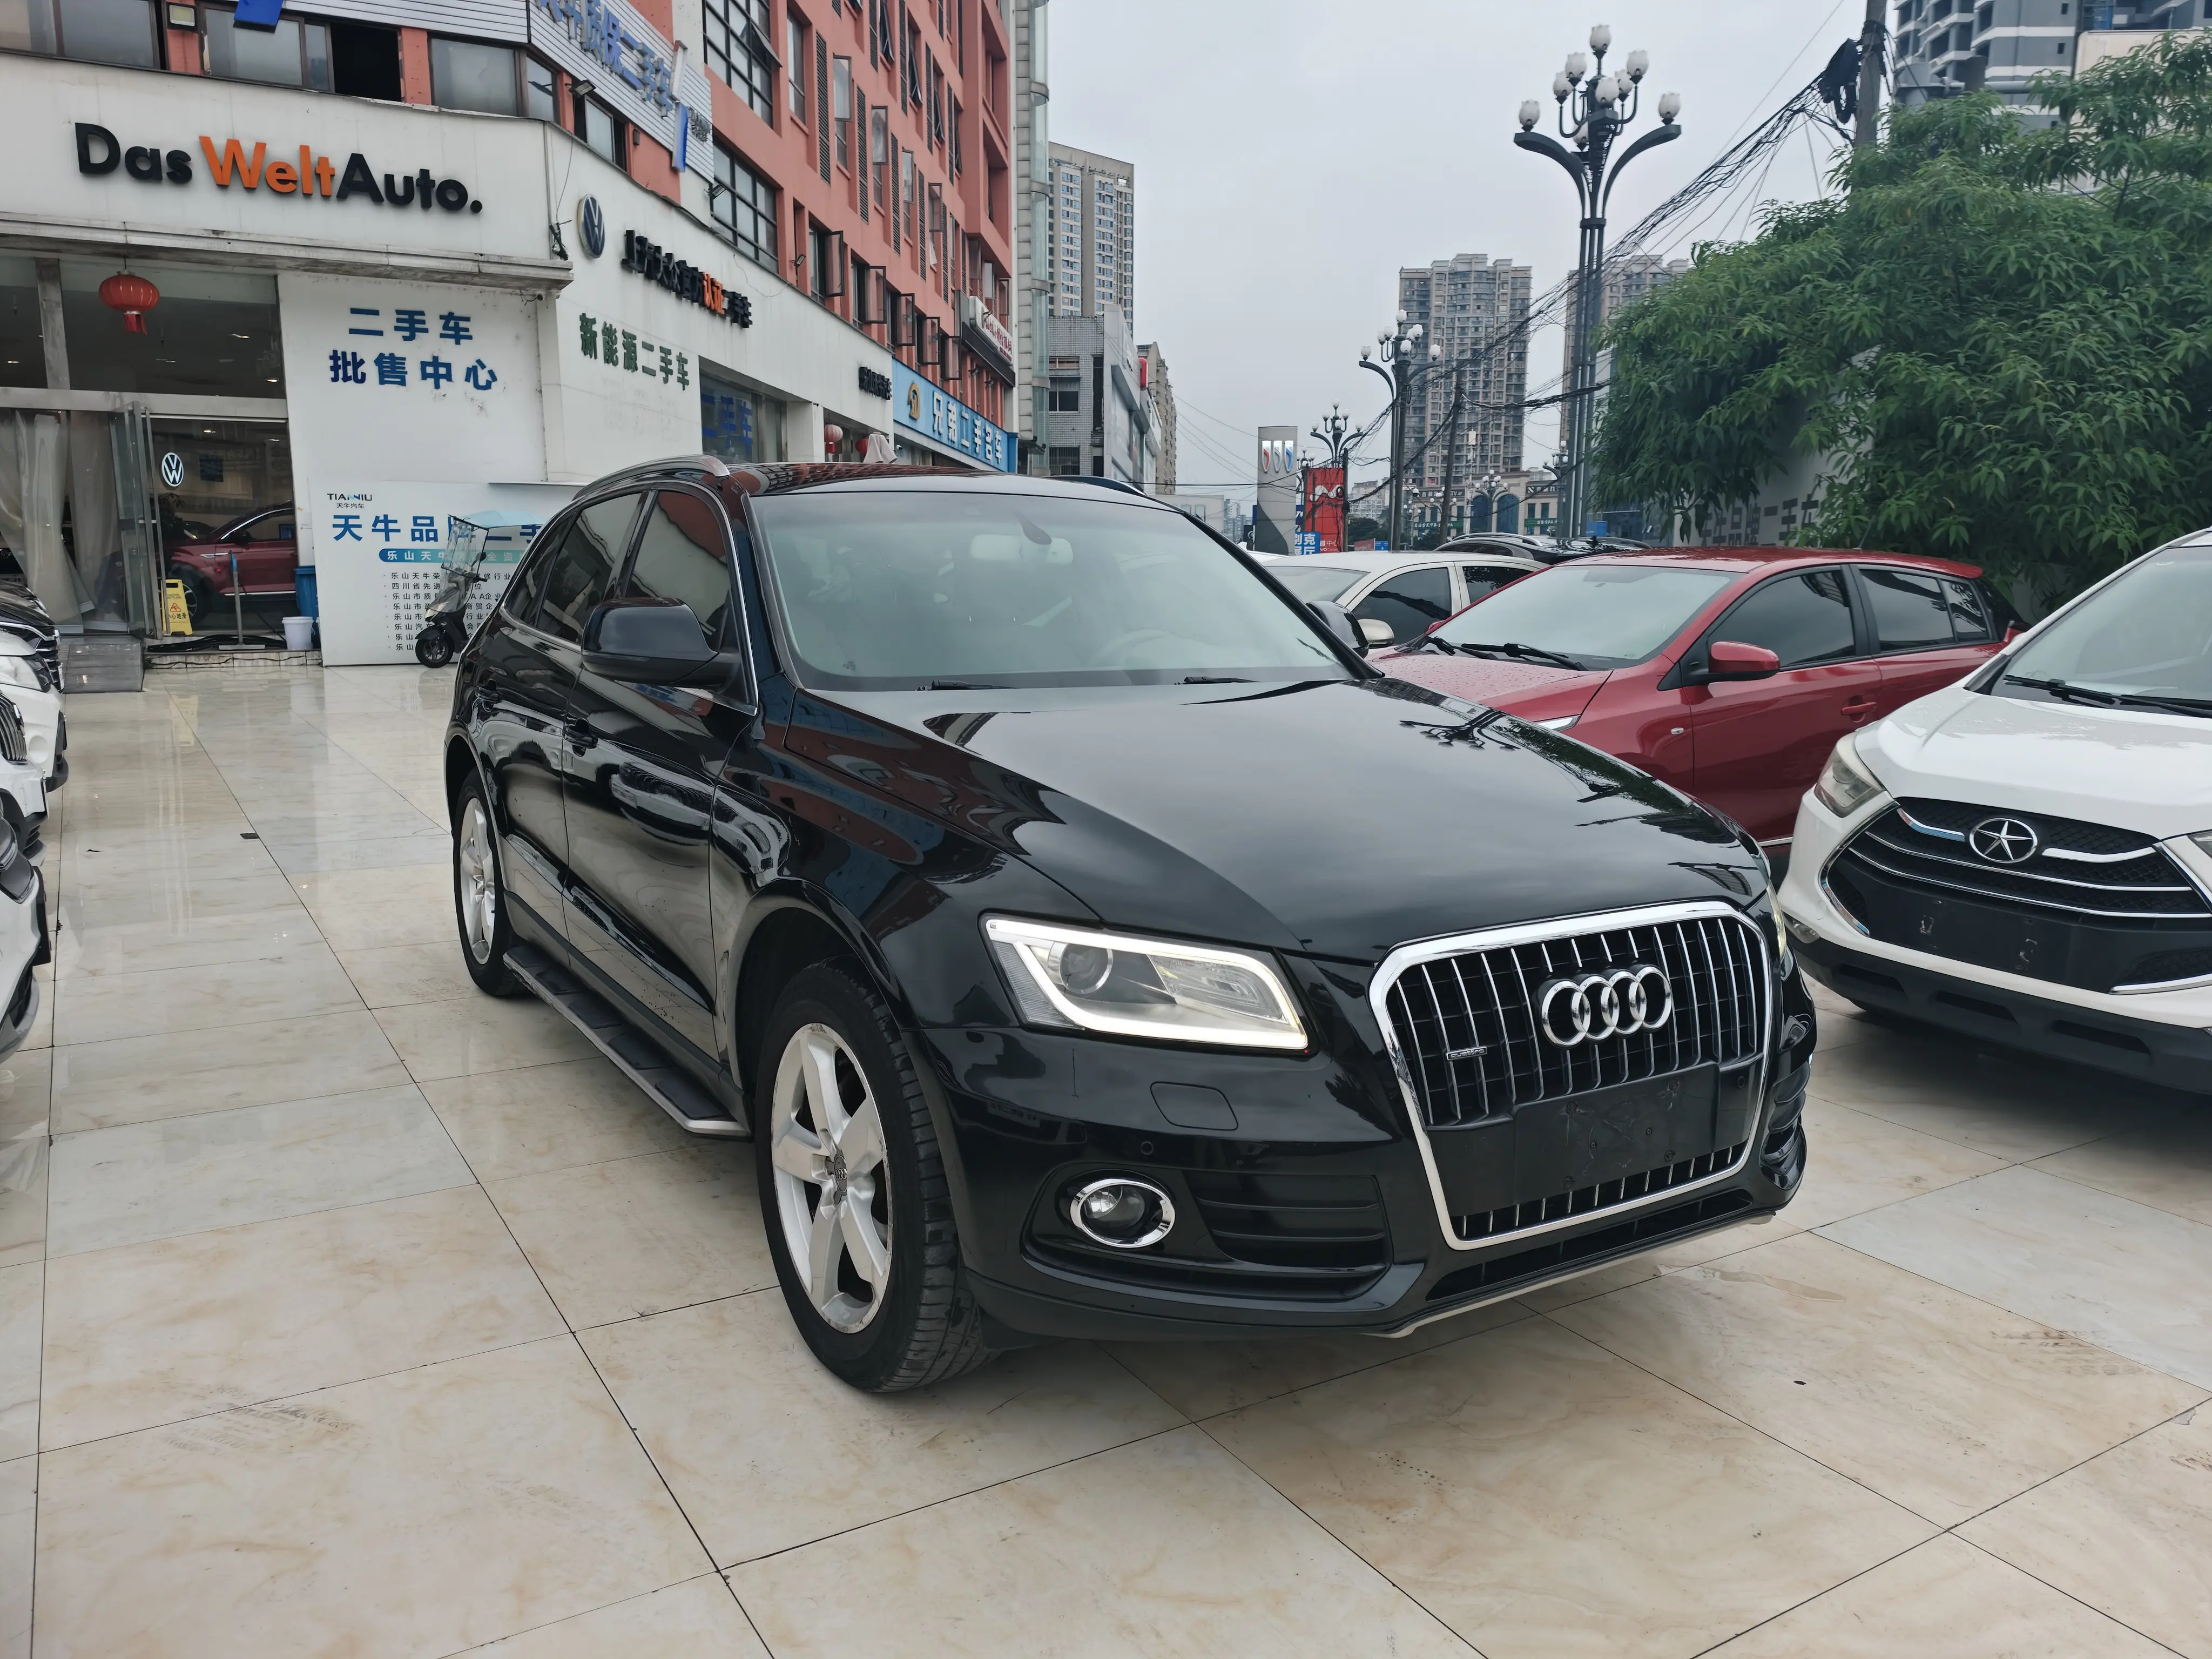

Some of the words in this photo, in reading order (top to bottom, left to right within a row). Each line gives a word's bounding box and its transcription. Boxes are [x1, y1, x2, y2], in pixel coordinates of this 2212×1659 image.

[75, 122, 193, 184] Das
[349, 307, 473, 346] 二手车
[579, 313, 690, 391] 新能源二手车
[329, 349, 498, 391] 批售中心
[701, 394, 753, 454] 二手车
[933, 391, 1002, 464] 兄弟二手名车
